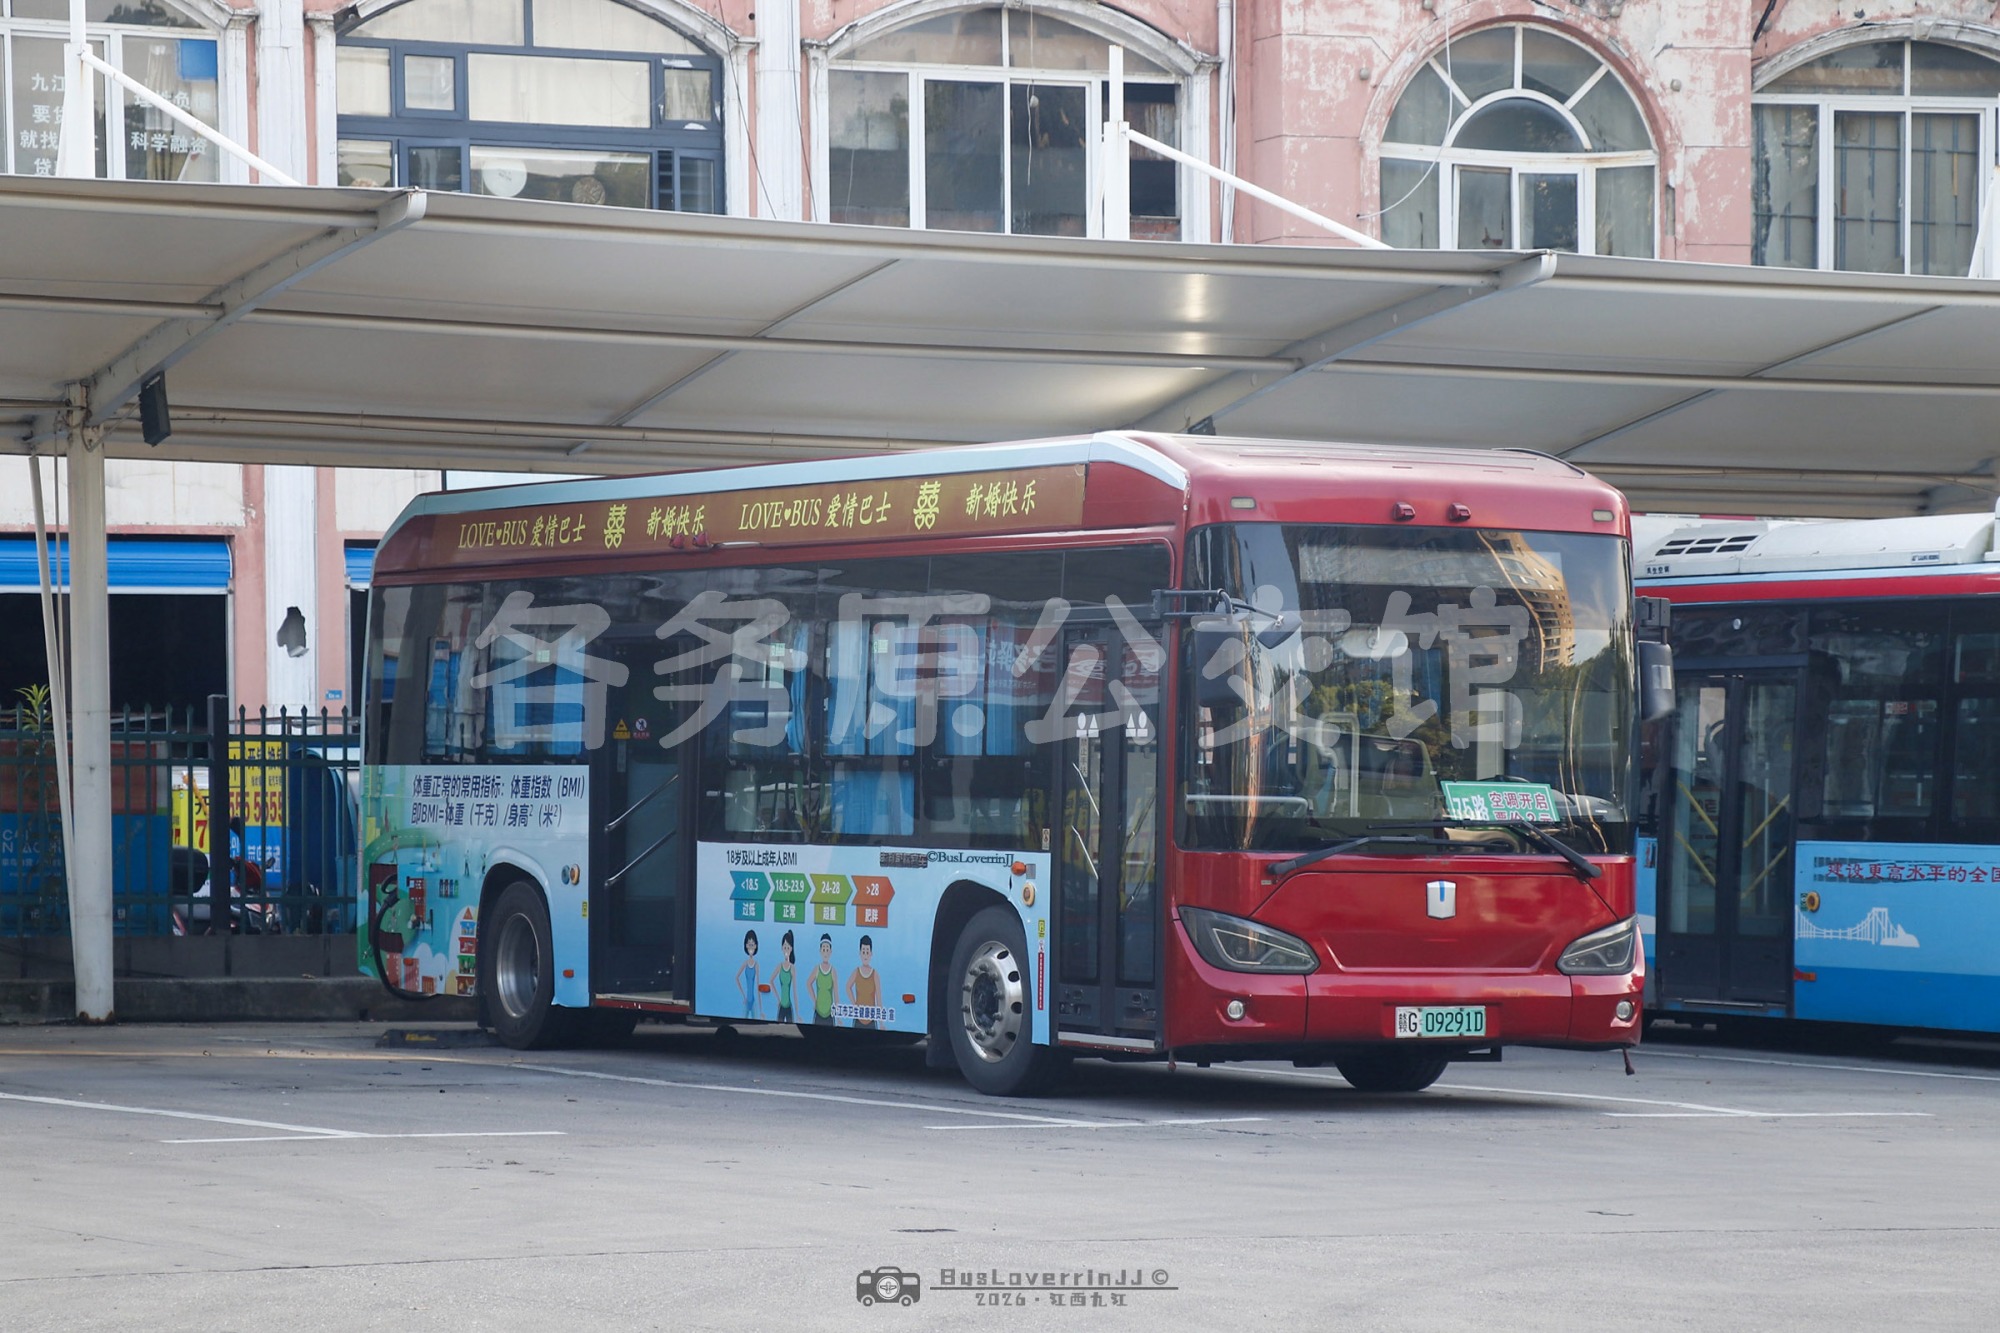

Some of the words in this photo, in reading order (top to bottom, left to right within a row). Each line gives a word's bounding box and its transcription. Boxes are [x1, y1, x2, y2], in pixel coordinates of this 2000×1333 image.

[130, 131, 207, 154] 科学融资
[966, 479, 1036, 521] 新婚快乐
[736, 502, 784, 530] LOVE
[789, 499, 821, 527] BUS
[825, 491, 891, 528] 爱情巴士
[530, 513, 585, 547] 爱情巴士
[647, 505, 705, 541] 新婚快乐
[458, 522, 496, 549] LOVE
[501, 520, 527, 545] BUS
[1488, 791, 1549, 810] 空调开启
[726, 850, 798, 867] 18岁及以上成年人BMI
[775, 879, 805, 893] 18.5-23.9
[821, 881, 841, 894] 24-28
[866, 883, 880, 896] >28
[742, 903, 756, 917] 过低
[782, 904, 796, 919] 正常
[822, 906, 837, 921] 超重
[864, 908, 879, 923] 肥胖
